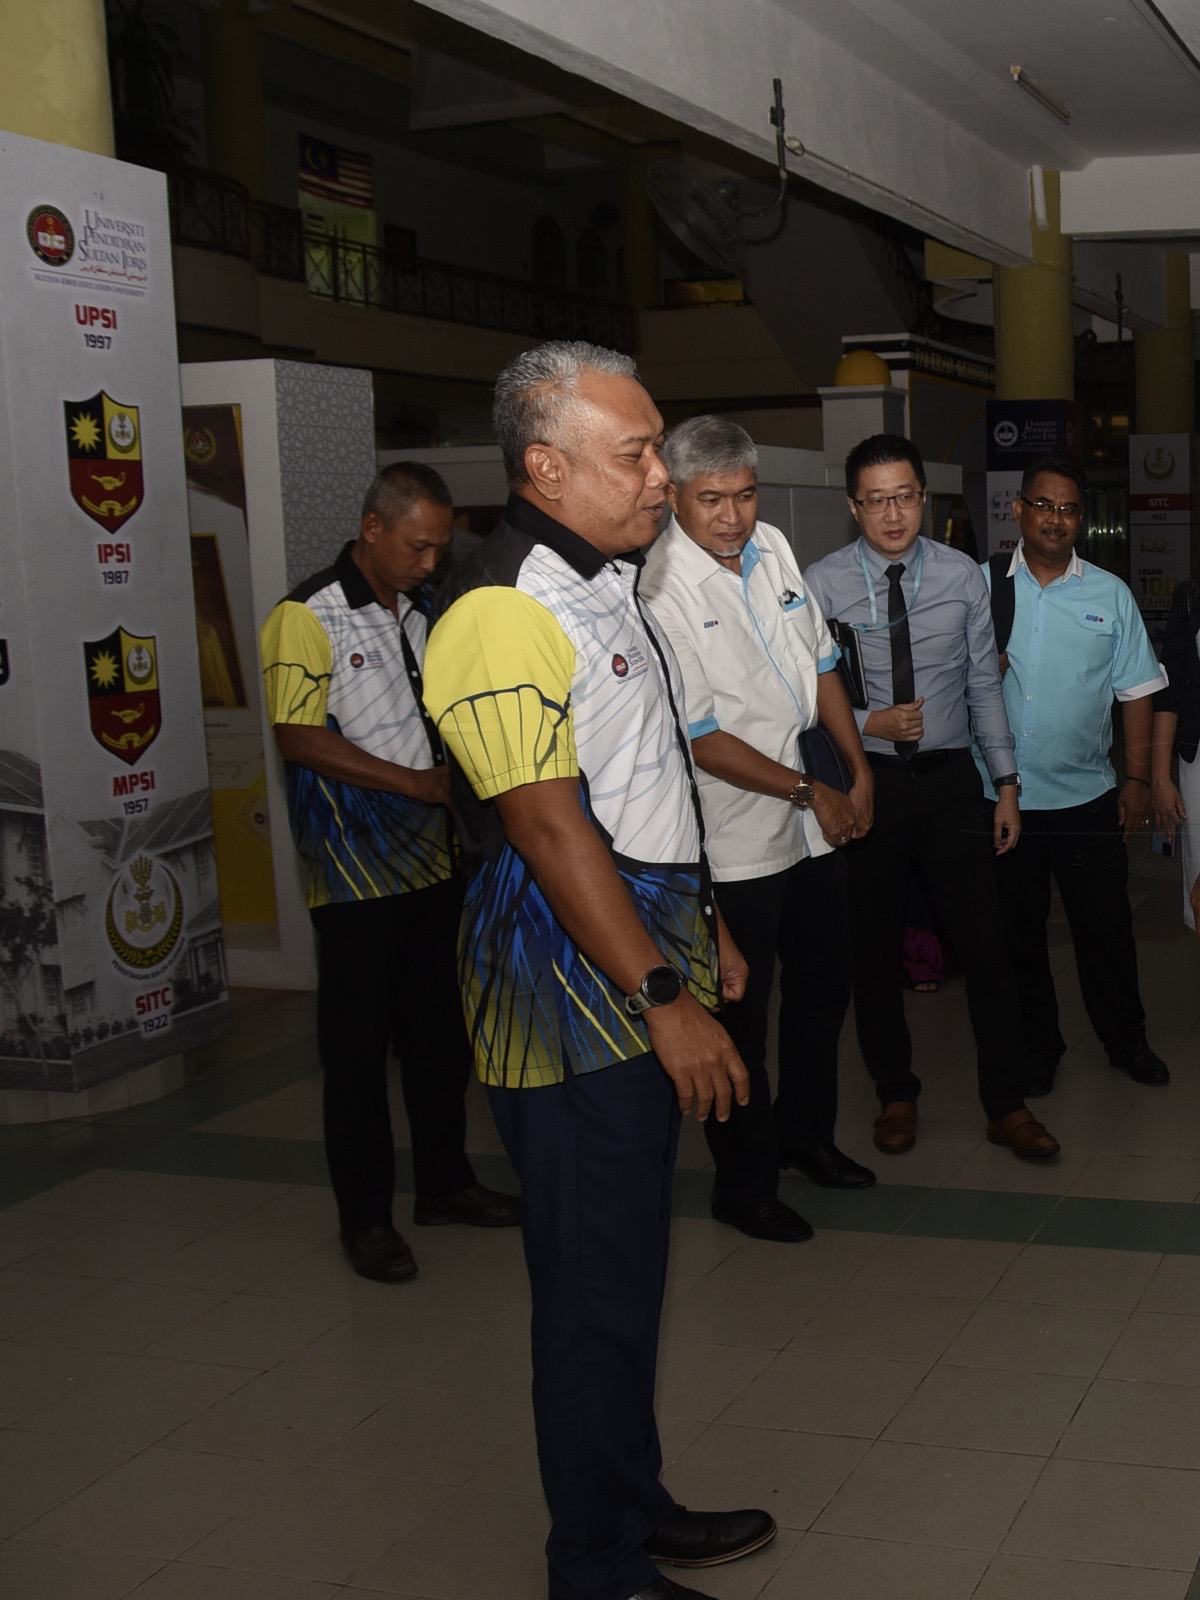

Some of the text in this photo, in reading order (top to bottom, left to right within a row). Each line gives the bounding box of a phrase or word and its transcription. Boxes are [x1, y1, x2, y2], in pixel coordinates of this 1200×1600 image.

[85, 209, 145, 237] UNIVERSITI
[83, 225, 146, 254] PENDIDIKAN
[78, 239, 147, 272] SULTAN IDRIS
[75, 304, 117, 329] UPSI
[83, 333, 112, 350] 1997
[1148, 497, 1170, 507] SITC
[97, 543, 131, 564] IPSI
[102, 570, 129, 585] 1987
[1139, 597, 1173, 609] TAHU
[1084, 613, 1099, 623] RHB
[113, 770, 156, 796] MPSI
[123, 798, 149, 815] 1957
[135, 986, 171, 1016] SITC
[142, 1013, 169, 1033] 1922
